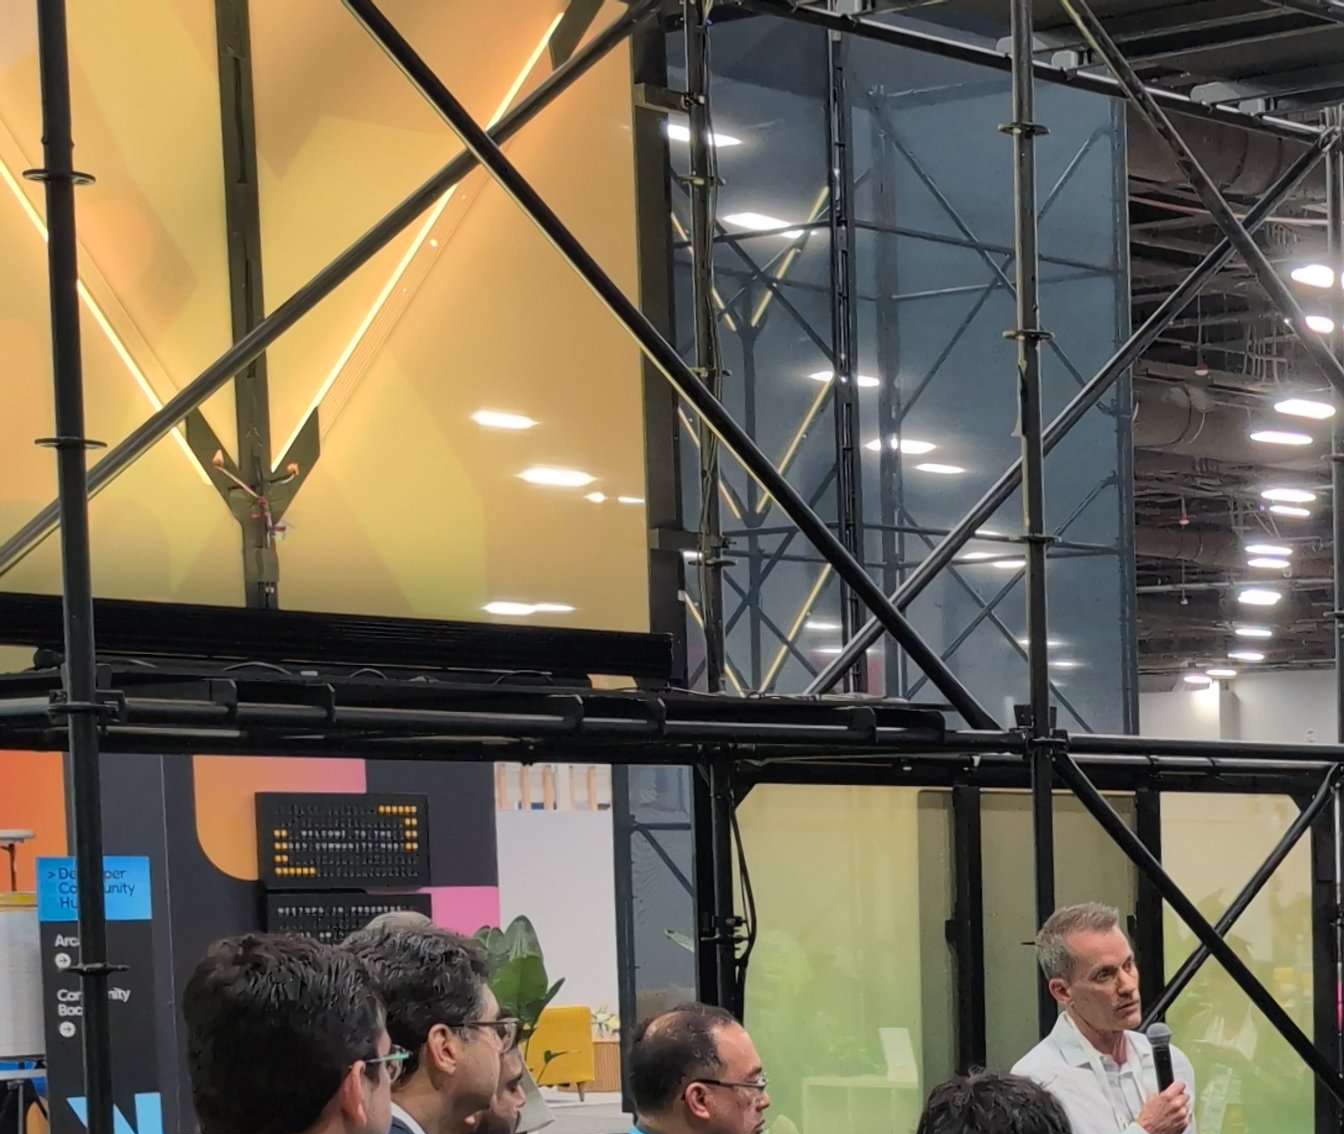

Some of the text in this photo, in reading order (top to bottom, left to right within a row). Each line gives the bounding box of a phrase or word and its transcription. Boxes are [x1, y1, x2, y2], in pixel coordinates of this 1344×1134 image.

[58, 882, 135, 896] Counity
[59, 897, 78, 909] Hu
[54, 934, 80, 948] Arc
[57, 987, 131, 1003] Conity
